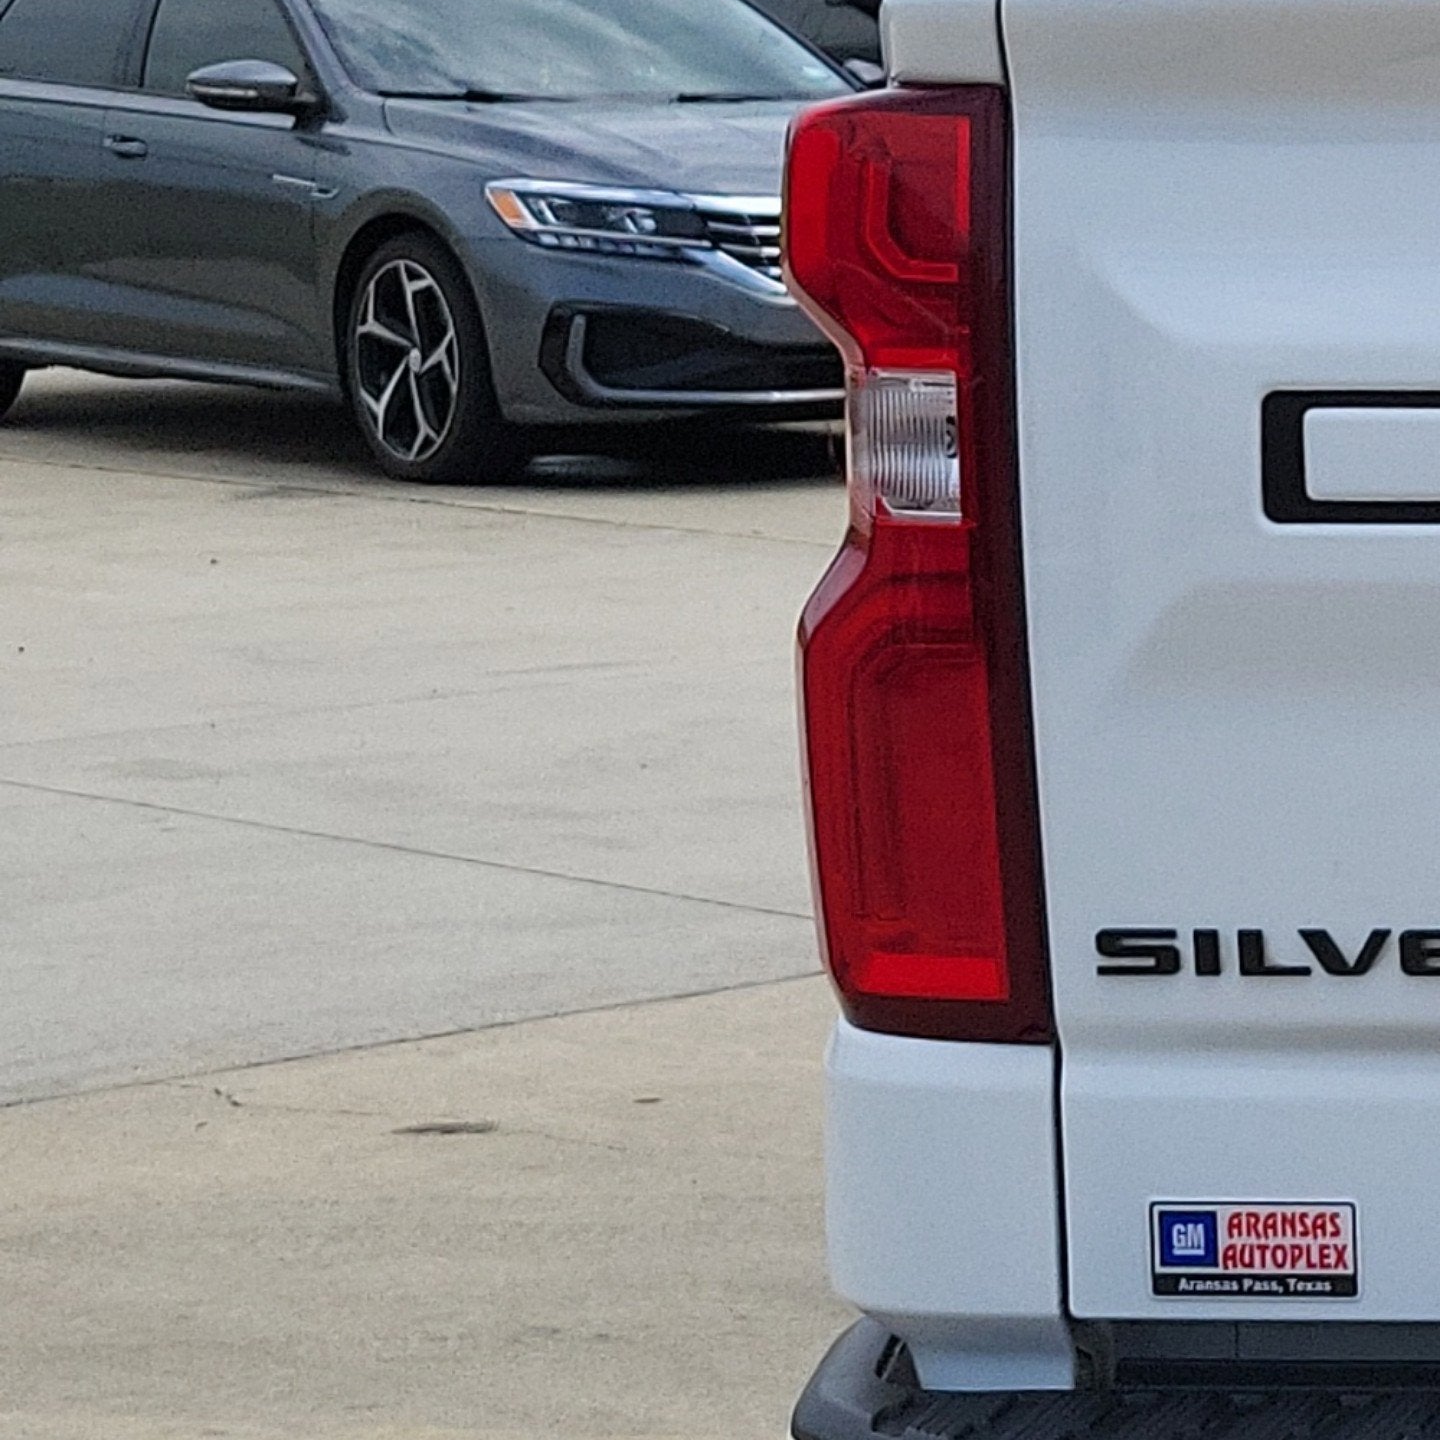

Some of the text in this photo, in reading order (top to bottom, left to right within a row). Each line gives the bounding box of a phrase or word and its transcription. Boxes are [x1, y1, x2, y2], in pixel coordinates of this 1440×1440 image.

[1172, 1223, 1205, 1250] GM
[1227, 1212, 1342, 1239] ARANSAS
[1222, 1243, 1348, 1270] AUTOPLEX
[1178, 1277, 1332, 1294] Aransas Pass, Texas
